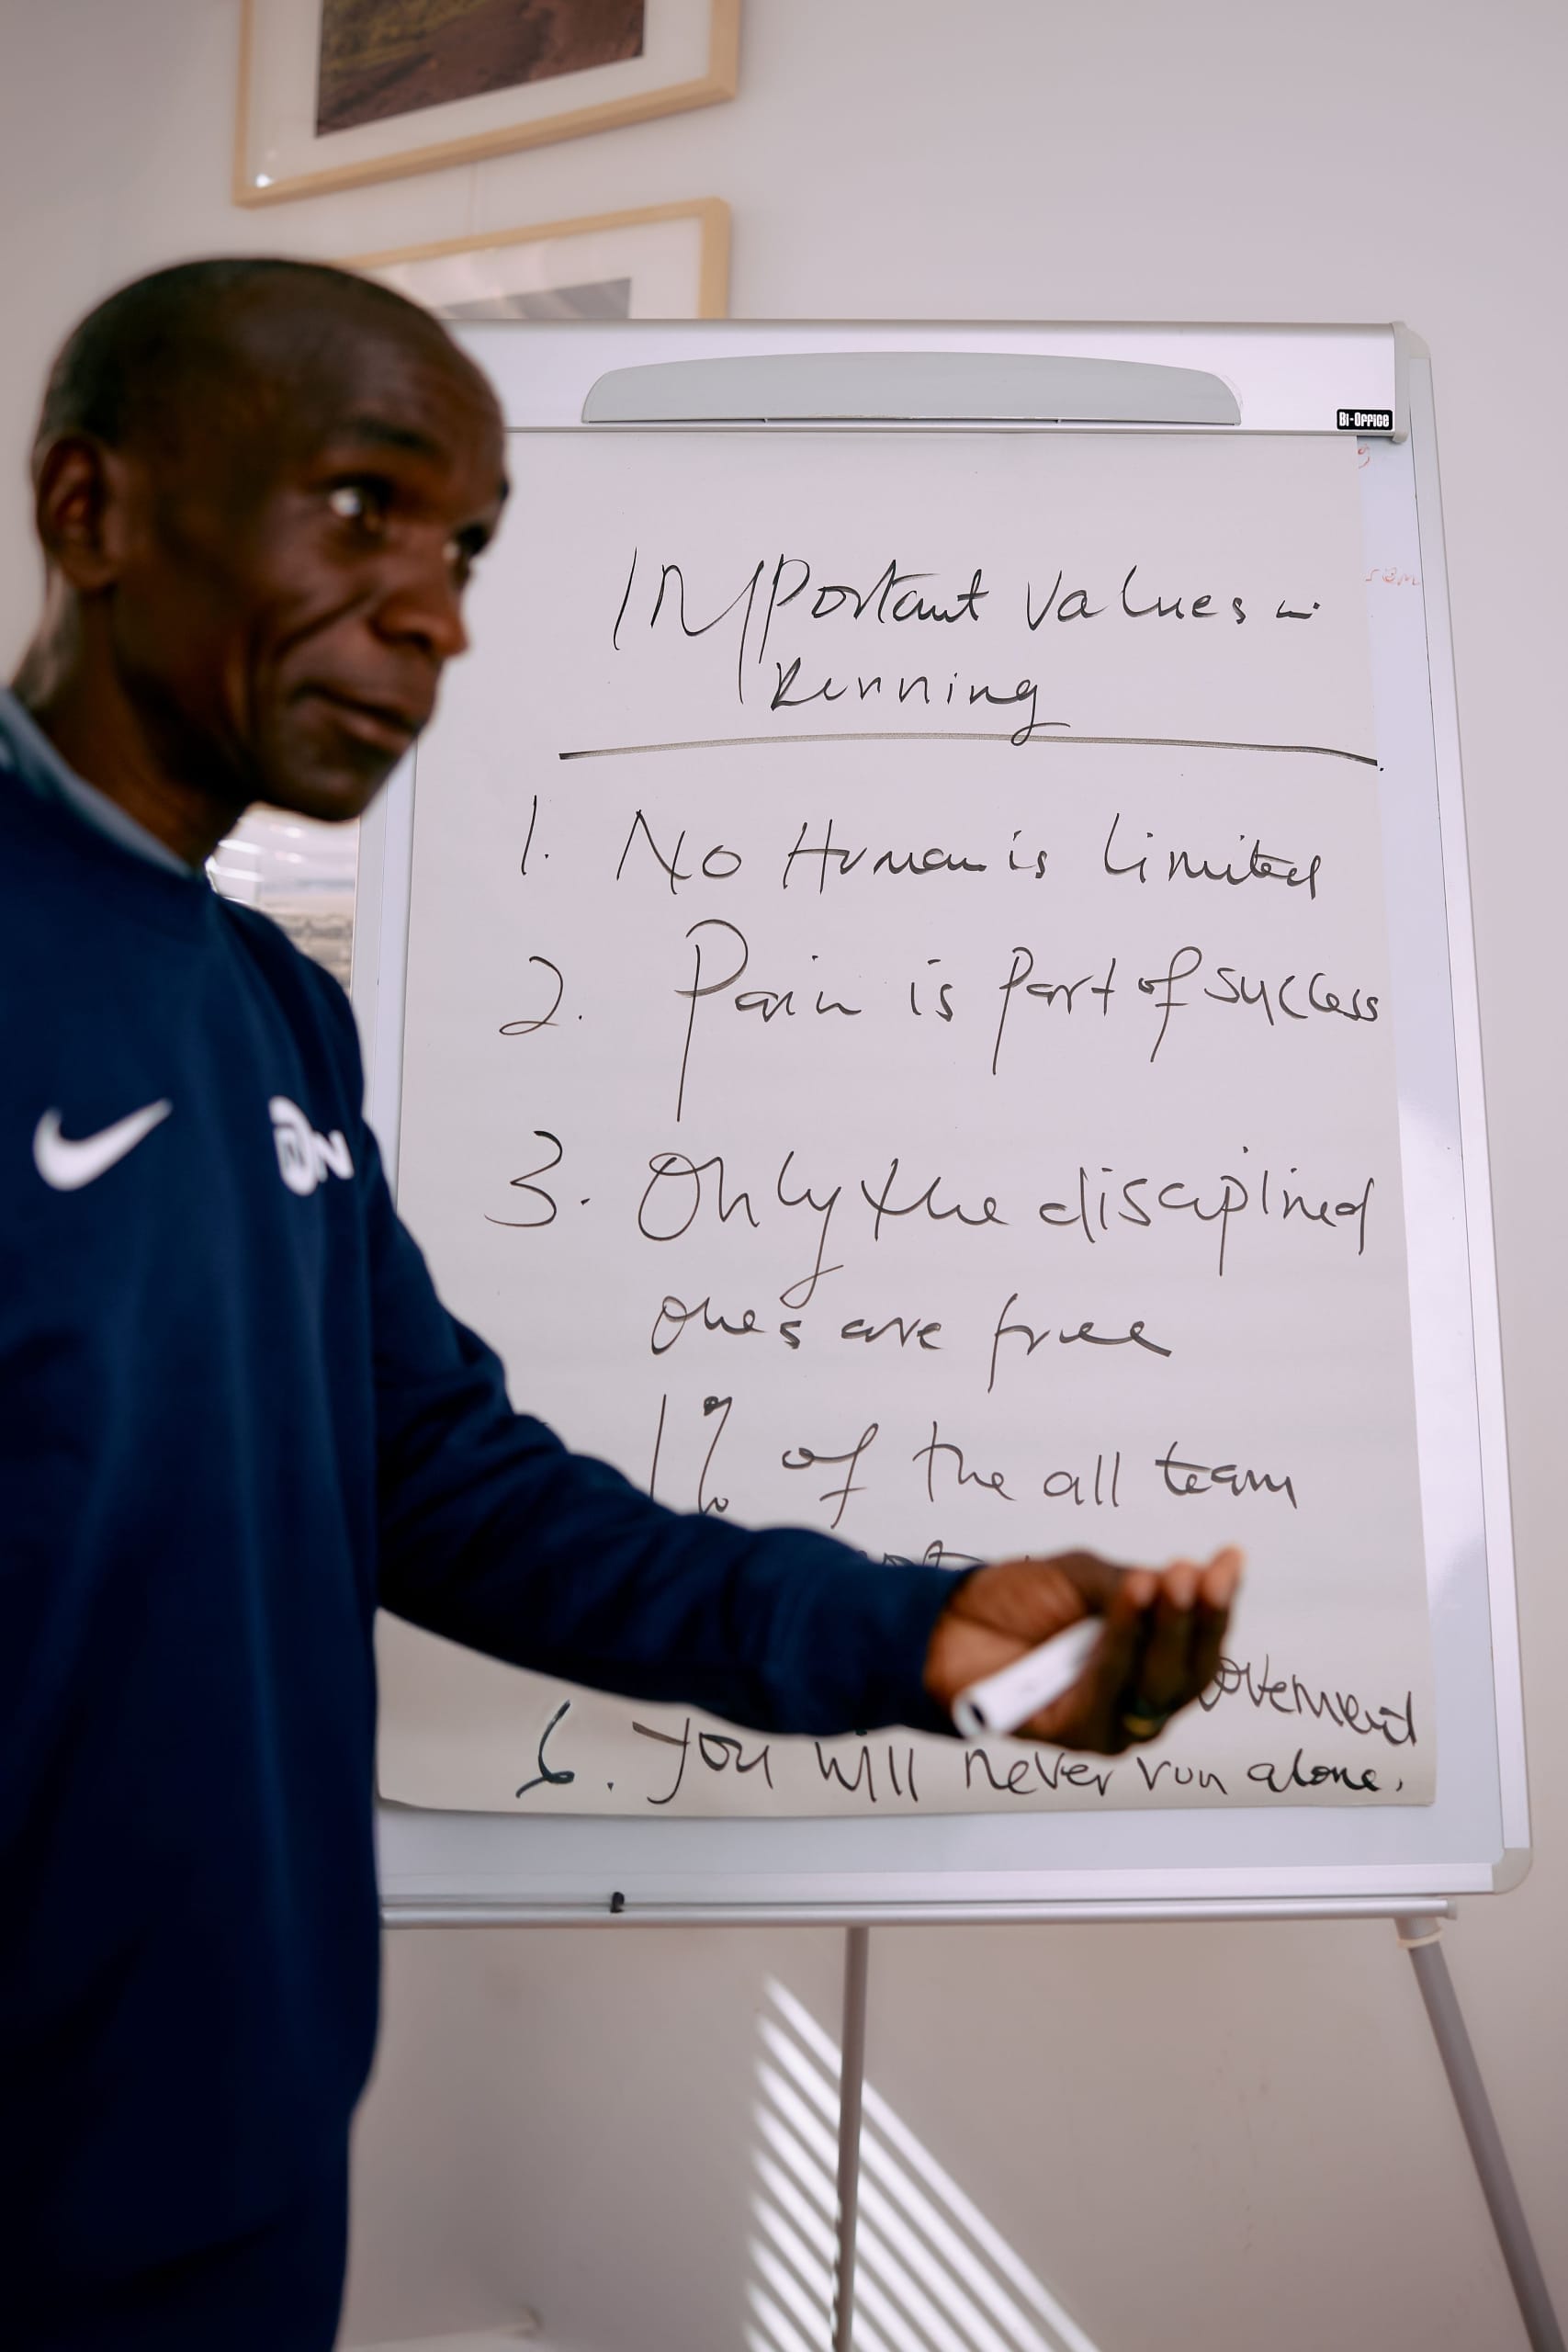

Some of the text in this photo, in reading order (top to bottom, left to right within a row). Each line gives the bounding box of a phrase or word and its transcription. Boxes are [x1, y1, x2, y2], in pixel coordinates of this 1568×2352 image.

[616, 808, 742, 895] No
[1010, 831, 1047, 879] is
[499, 956, 583, 1035] 2.
[674, 919, 862, 1122] Pain
[909, 958, 953, 1022] is
[1138, 946, 1202, 1063] of
[484, 1130, 591, 1228] 3.
[638, 1151, 844, 1310] Only
[1039, 1147, 1375, 1277] disciplined
[651, 1294, 1173, 1394] ones are free
[782, 1422, 880, 1529] of
[912, 1420, 1016, 1503] the
[1043, 1451, 1121, 1507] all
[1155, 1441, 1298, 1510] team
[514, 1700, 615, 1799] 6.
[1137, 1755, 1229, 1795] run
